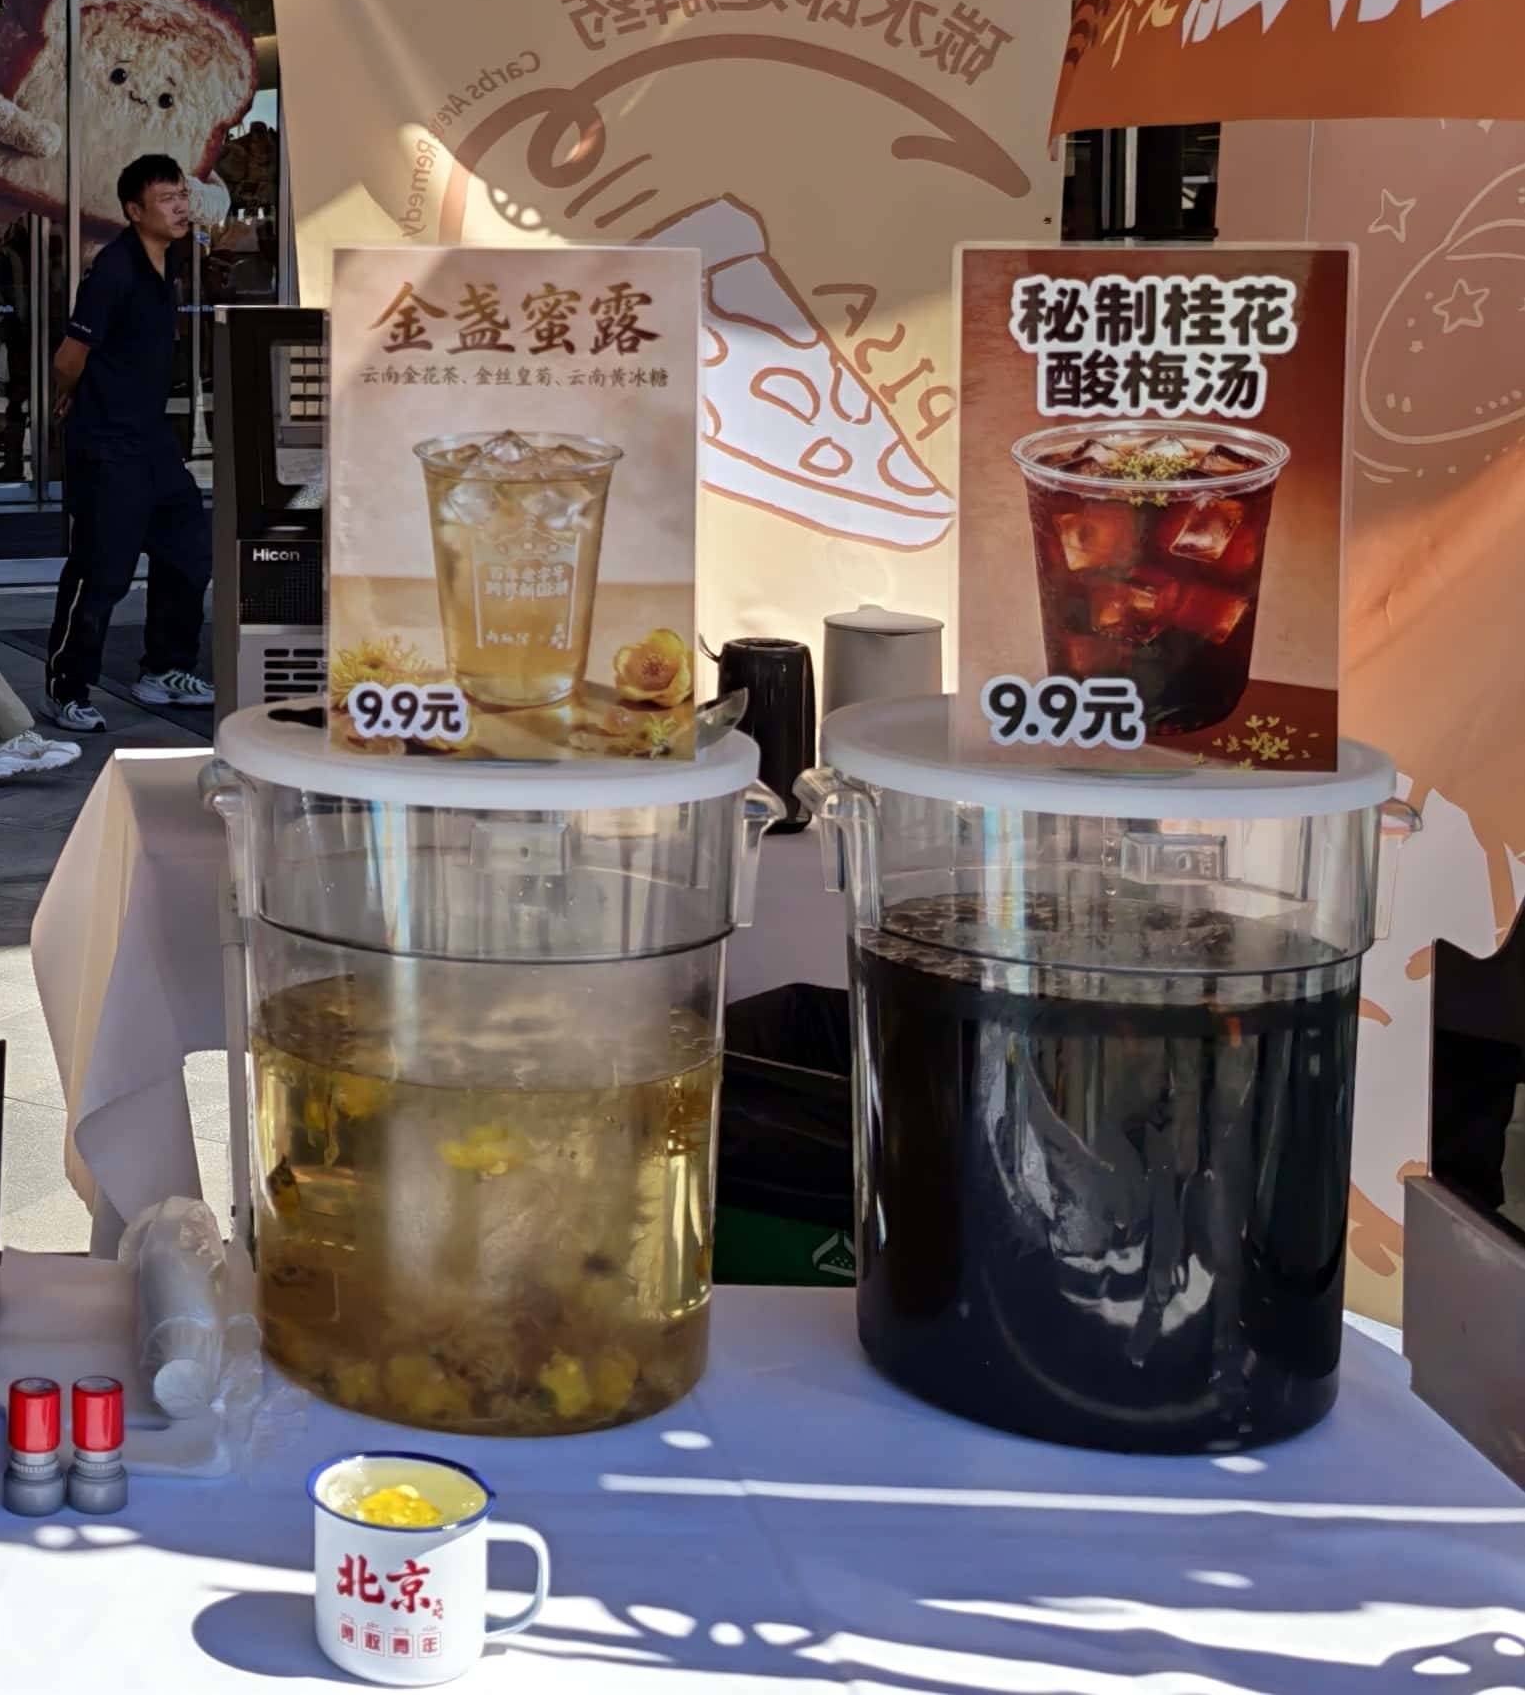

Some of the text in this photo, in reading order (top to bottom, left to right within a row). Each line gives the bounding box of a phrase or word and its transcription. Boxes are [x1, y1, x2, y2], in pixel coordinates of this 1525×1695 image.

[371, 281, 660, 355] 金盏蜜露
[1018, 282, 1290, 346] 秘制桂花
[1047, 351, 1258, 409] 酸梅汤
[253, 548, 299, 561] Hicon
[357, 691, 461, 732] 9.9元
[989, 684, 1137, 741] 9.9元
[337, 1554, 430, 1613] 北京
